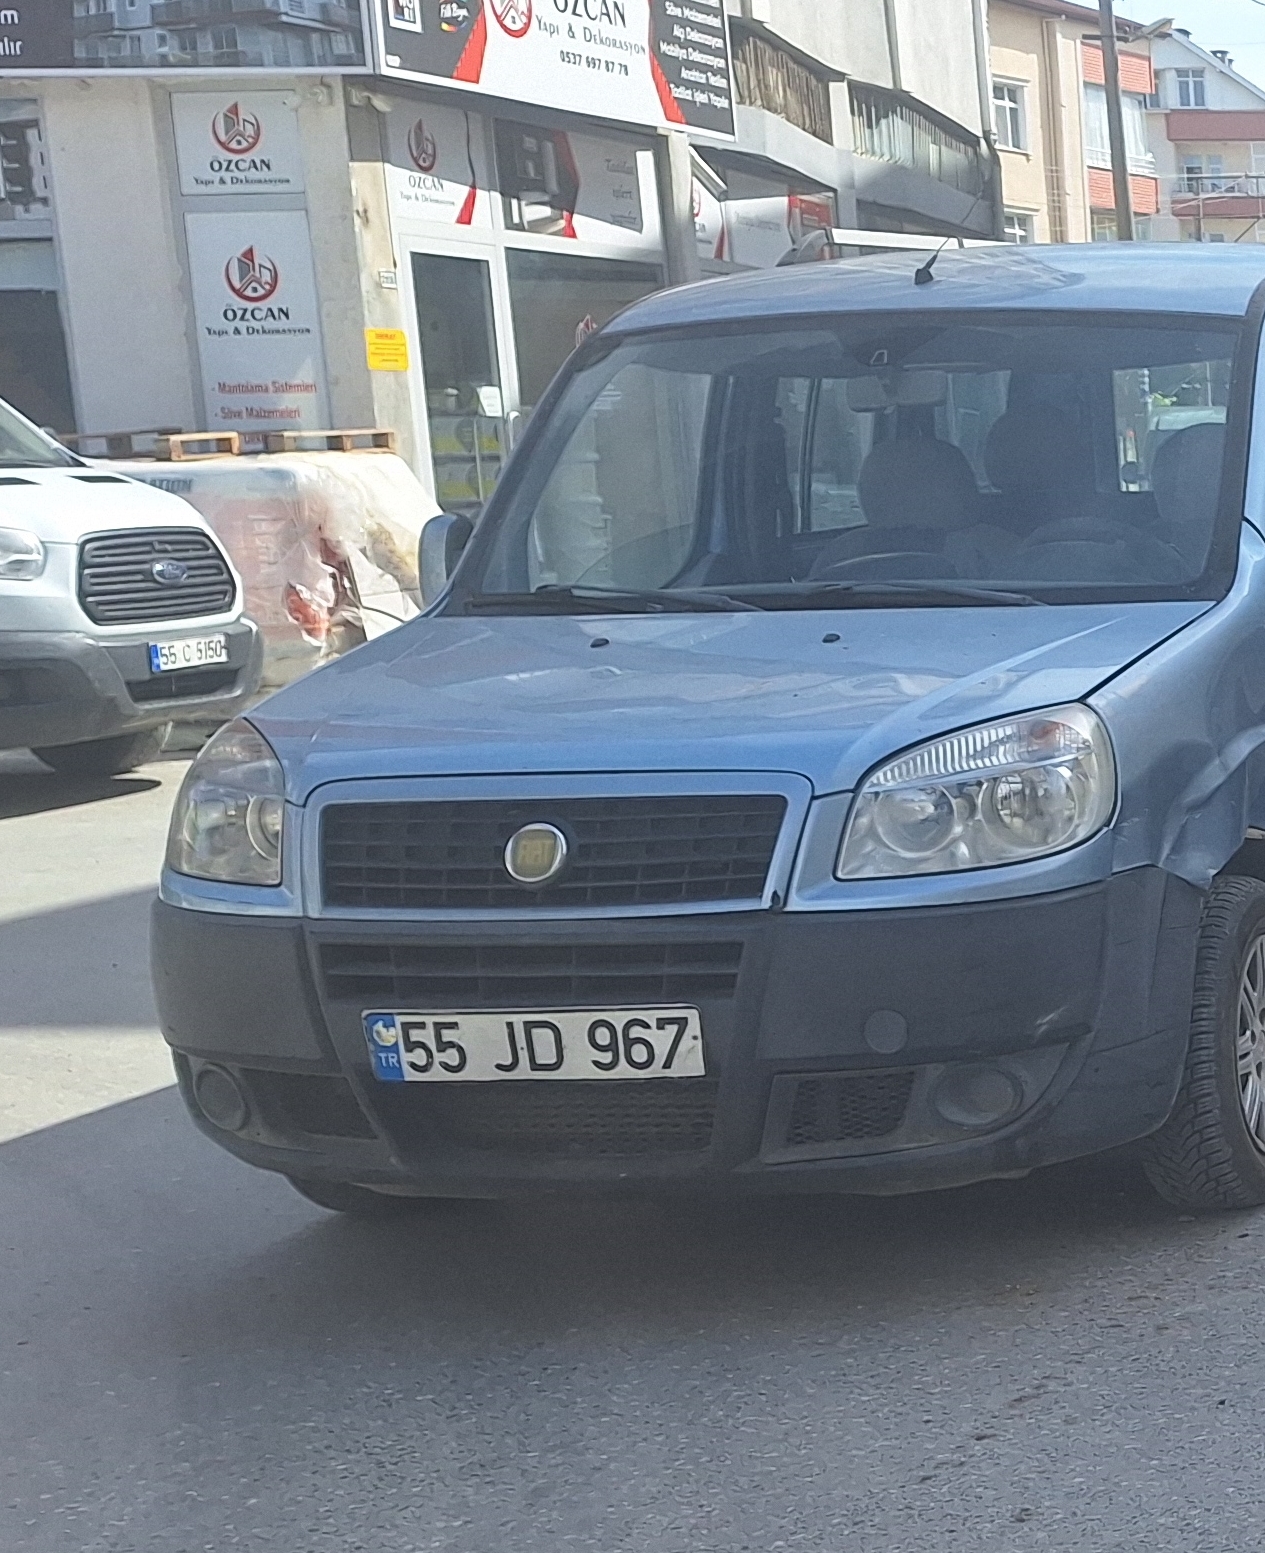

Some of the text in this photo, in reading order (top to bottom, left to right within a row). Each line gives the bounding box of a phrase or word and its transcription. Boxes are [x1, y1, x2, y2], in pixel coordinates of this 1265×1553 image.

[567, 22, 576, 39] &
[560, 50, 582, 66] 0537
[218, 176, 226, 185] &
[232, 326, 241, 336] &
[160, 645, 177, 665] 55
[183, 645, 191, 662] C
[196, 640, 222, 660] 5150
[400, 1017, 688, 1073] 55 JD 967
[378, 1052, 399, 1068] TR
